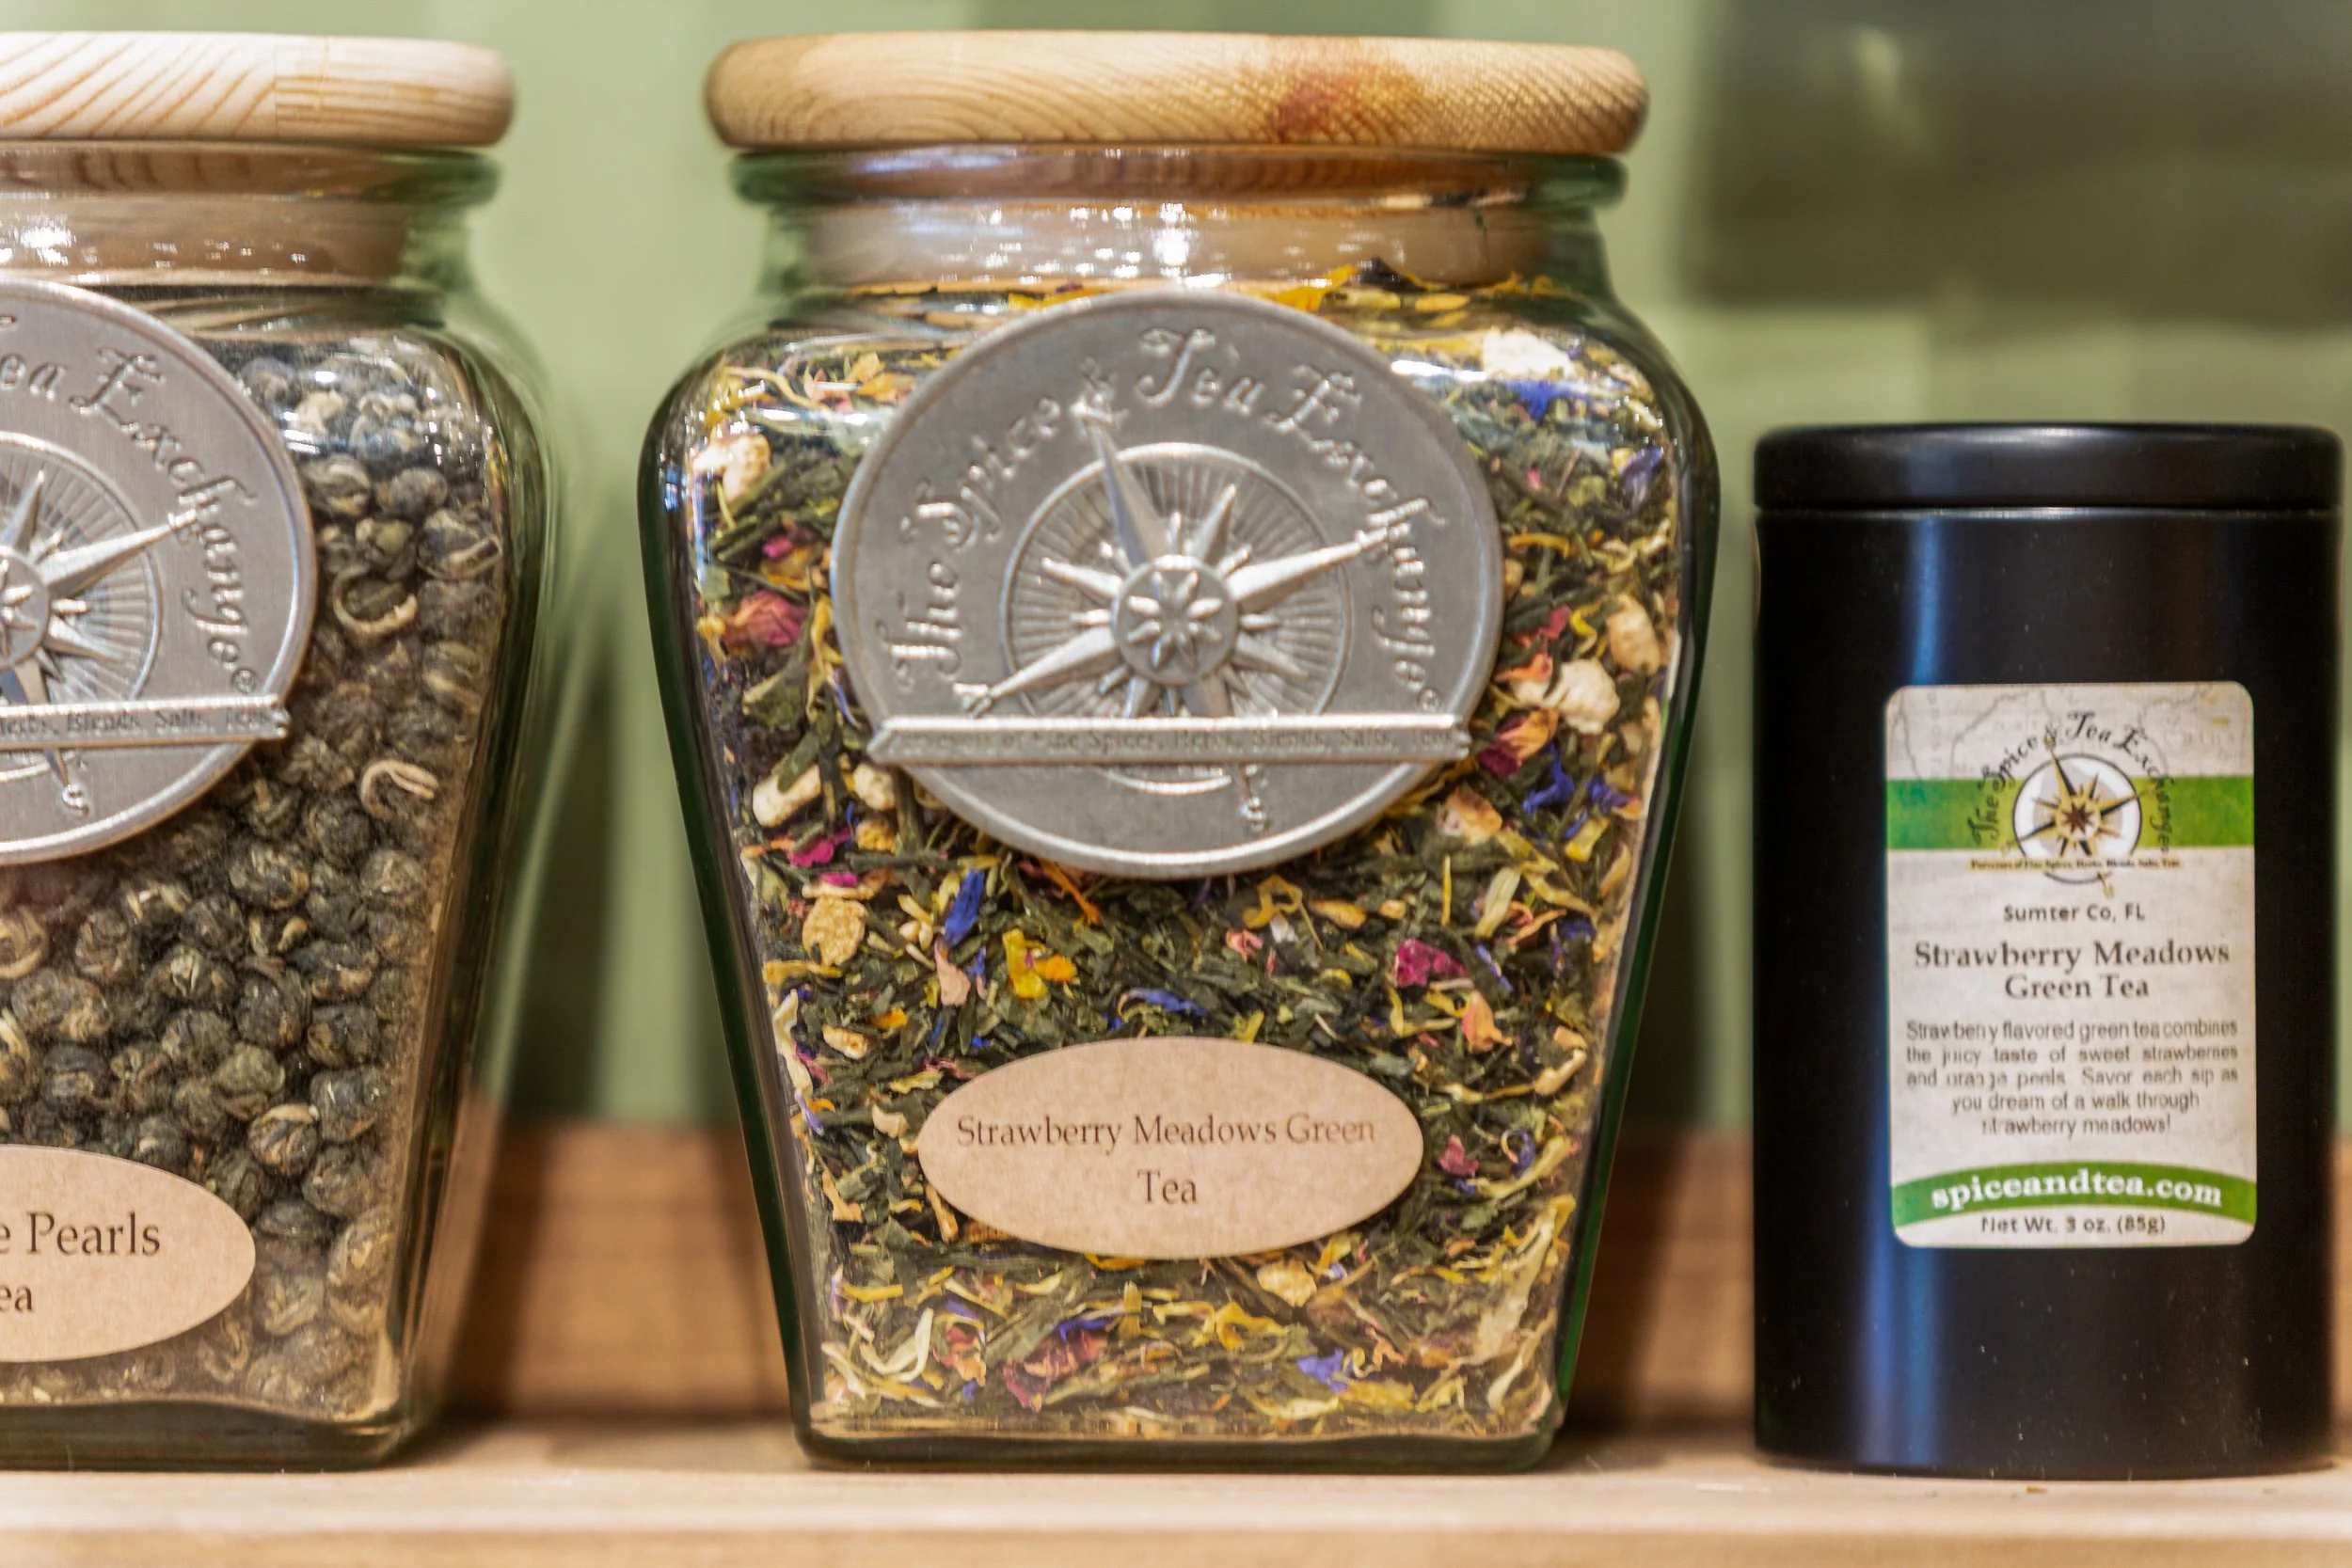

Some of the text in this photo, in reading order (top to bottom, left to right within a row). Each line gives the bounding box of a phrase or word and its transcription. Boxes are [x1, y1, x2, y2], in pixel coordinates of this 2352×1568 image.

[0, 316, 66, 401] ea
[1134, 328, 1264, 416] Tea
[1977, 736, 2040, 791] Spice
[2066, 709, 2111, 742] Tea
[2004, 903, 2146, 924] Sumter Co, FL
[1915, 939, 2231, 974] Strawberry Meadows
[2005, 973, 2150, 1000] Green Tea
[2002, 1020, 2074, 1040] flavored
[2078, 1021, 2129, 1045] green
[2133, 1020, 2160, 1039] tea
[2162, 1018, 2238, 1038] combines
[1906, 1042, 2238, 1069] the juicy taste of sweet strawberries
[1906, 1068, 1938, 1086] and
[2081, 1066, 2133, 1085] Savor
[2141, 1065, 2183, 1085] each
[2191, 1068, 2215, 1088] sip
[2220, 1067, 2238, 1083] as
[1951, 1088, 2201, 1118] you dream of a walk through
[958, 1112, 1375, 1155] Strawberry Meadows Green
[2082, 1112, 2171, 1134] meadows!
[1136, 1168, 1199, 1205] Tea
[1930, 1167, 2222, 1212] spiceandtea.com
[25, 1210, 161, 1257] Pearls
[1980, 1215, 2018, 1234] Net
[2082, 1216, 2111, 1234] oz.
[2117, 1214, 2166, 1236] (85g)
[0, 1284, 34, 1313] ea
